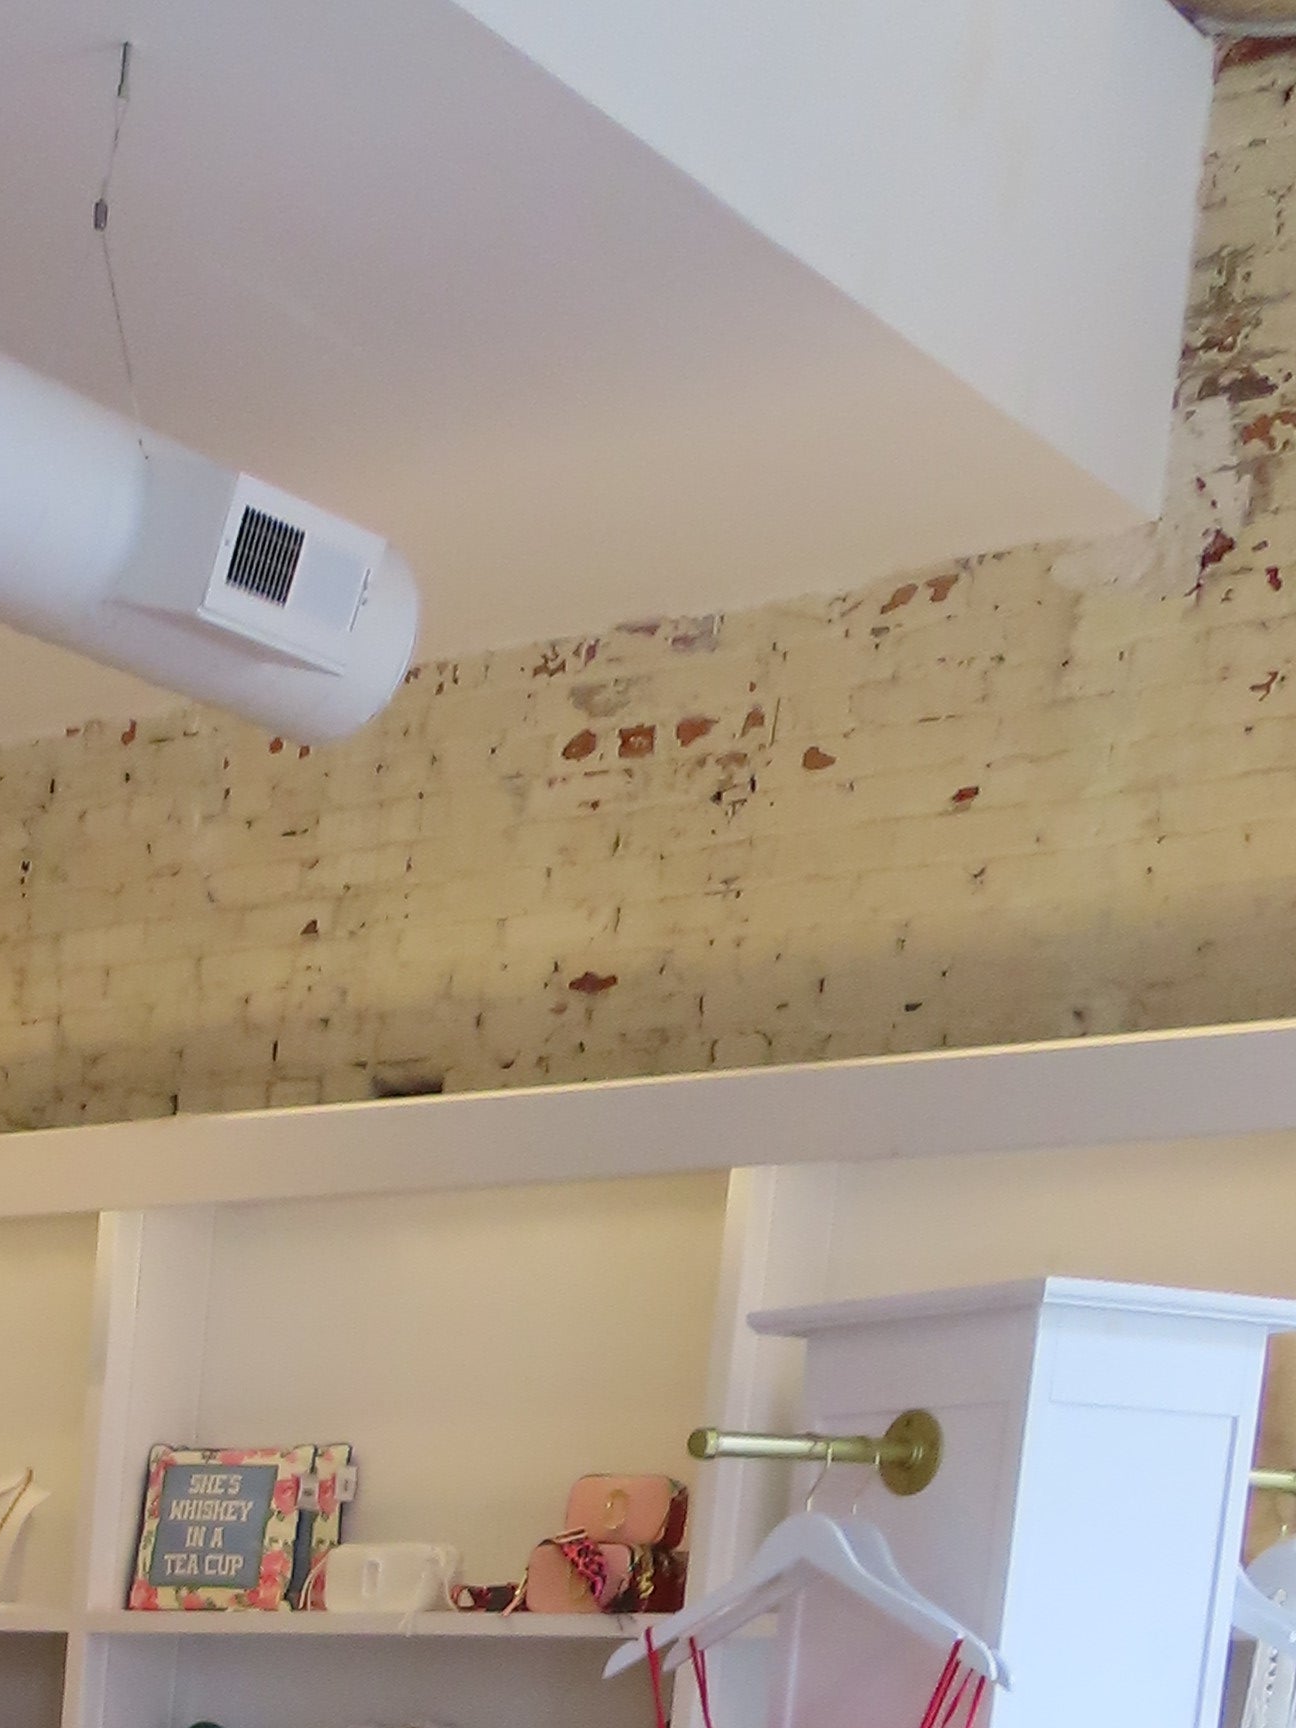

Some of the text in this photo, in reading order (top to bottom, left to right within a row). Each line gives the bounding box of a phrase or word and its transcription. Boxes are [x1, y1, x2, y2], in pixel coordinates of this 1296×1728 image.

[168, 1499, 254, 1522] WHISKEY
[184, 1525, 224, 1548] IN A
[163, 1553, 244, 1577] TEA CUP
